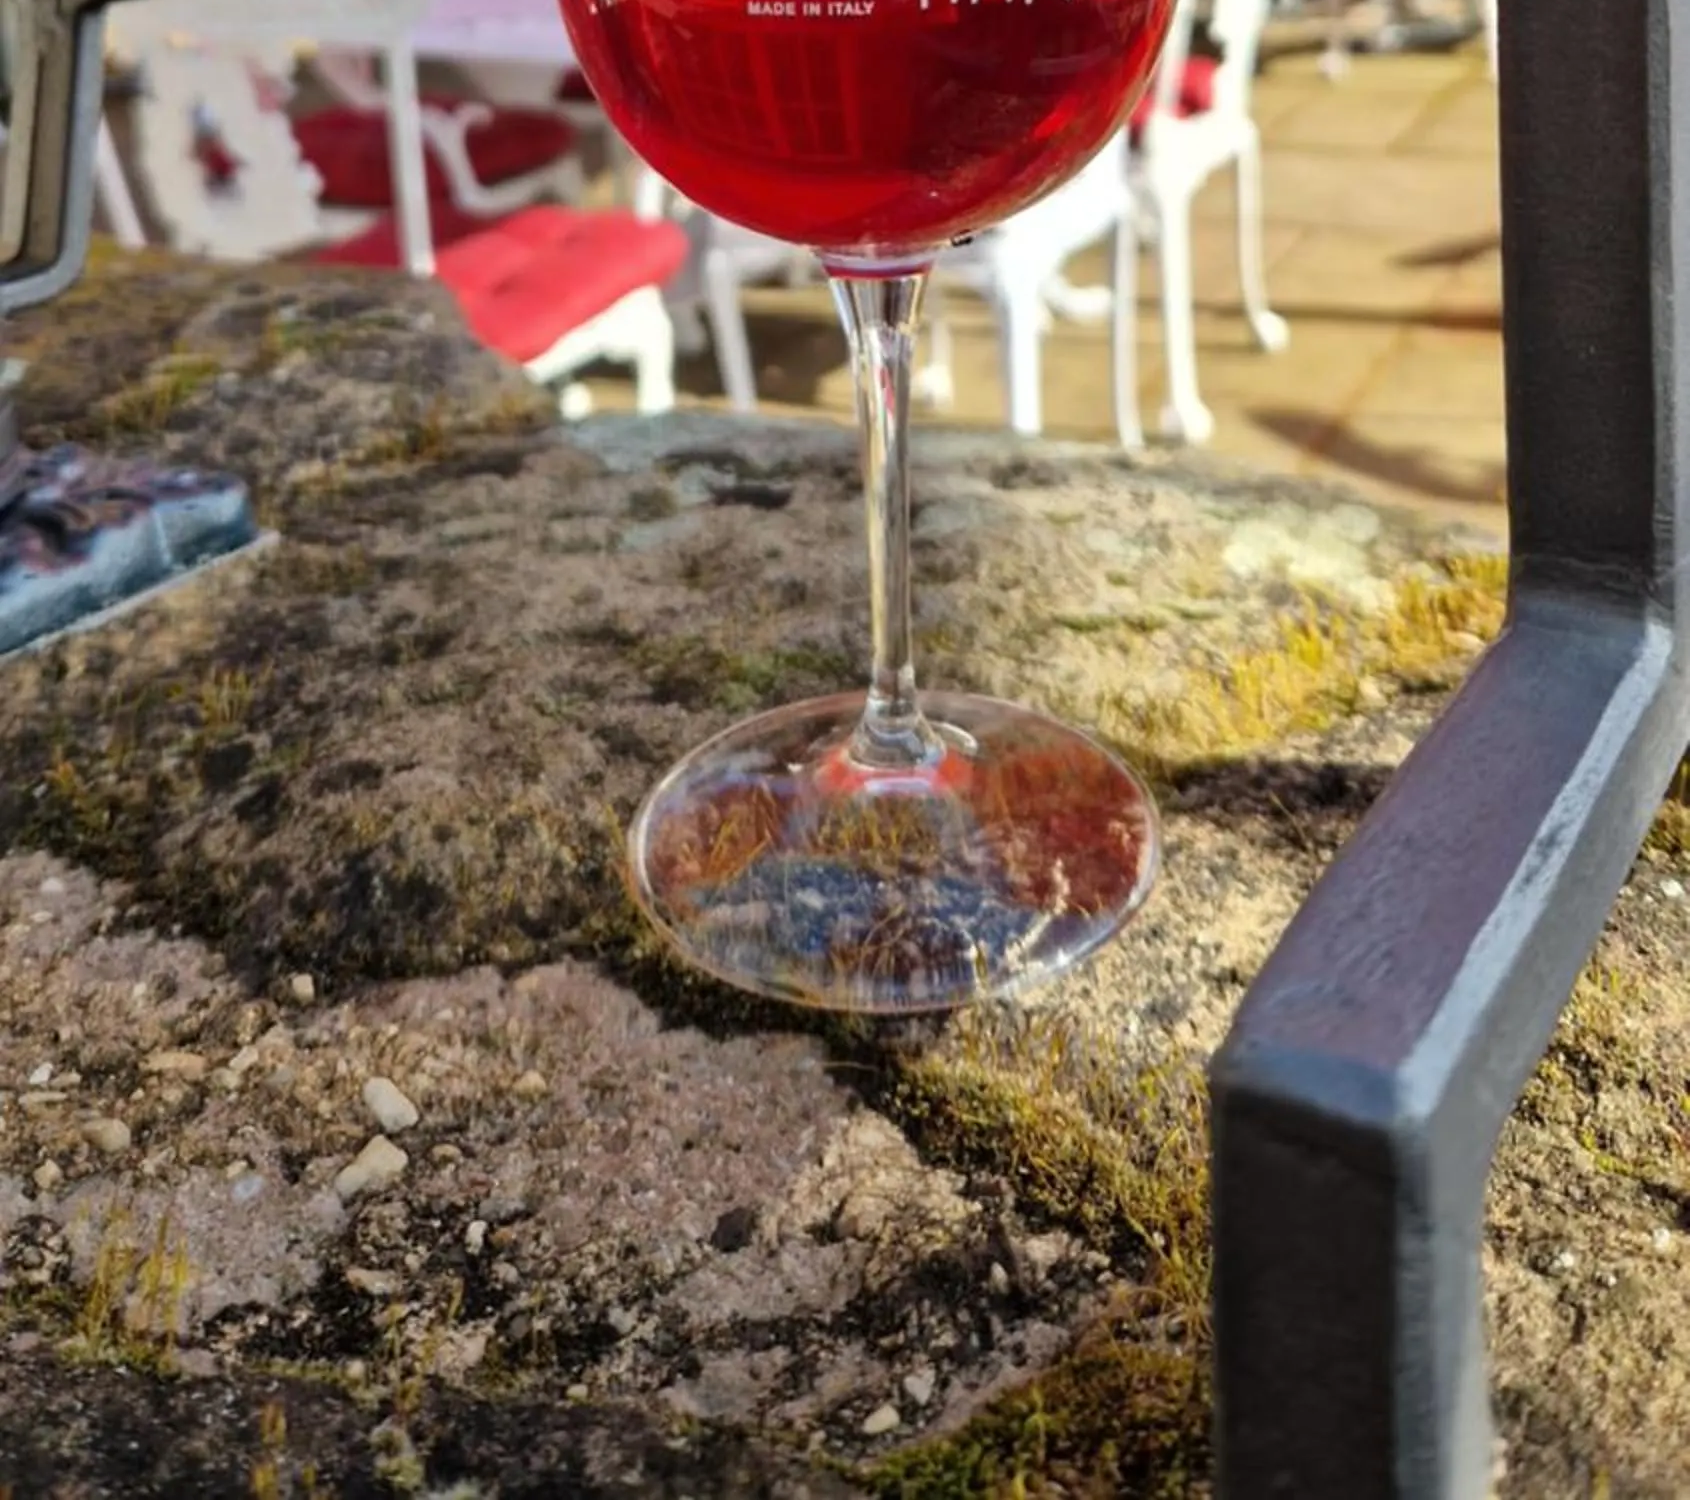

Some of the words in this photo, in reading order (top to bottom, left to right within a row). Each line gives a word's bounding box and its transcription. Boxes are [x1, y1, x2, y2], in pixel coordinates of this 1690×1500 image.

[747, 1, 796, 16] MADE
[803, 1, 821, 16] IN
[827, 1, 875, 16] ITALY
